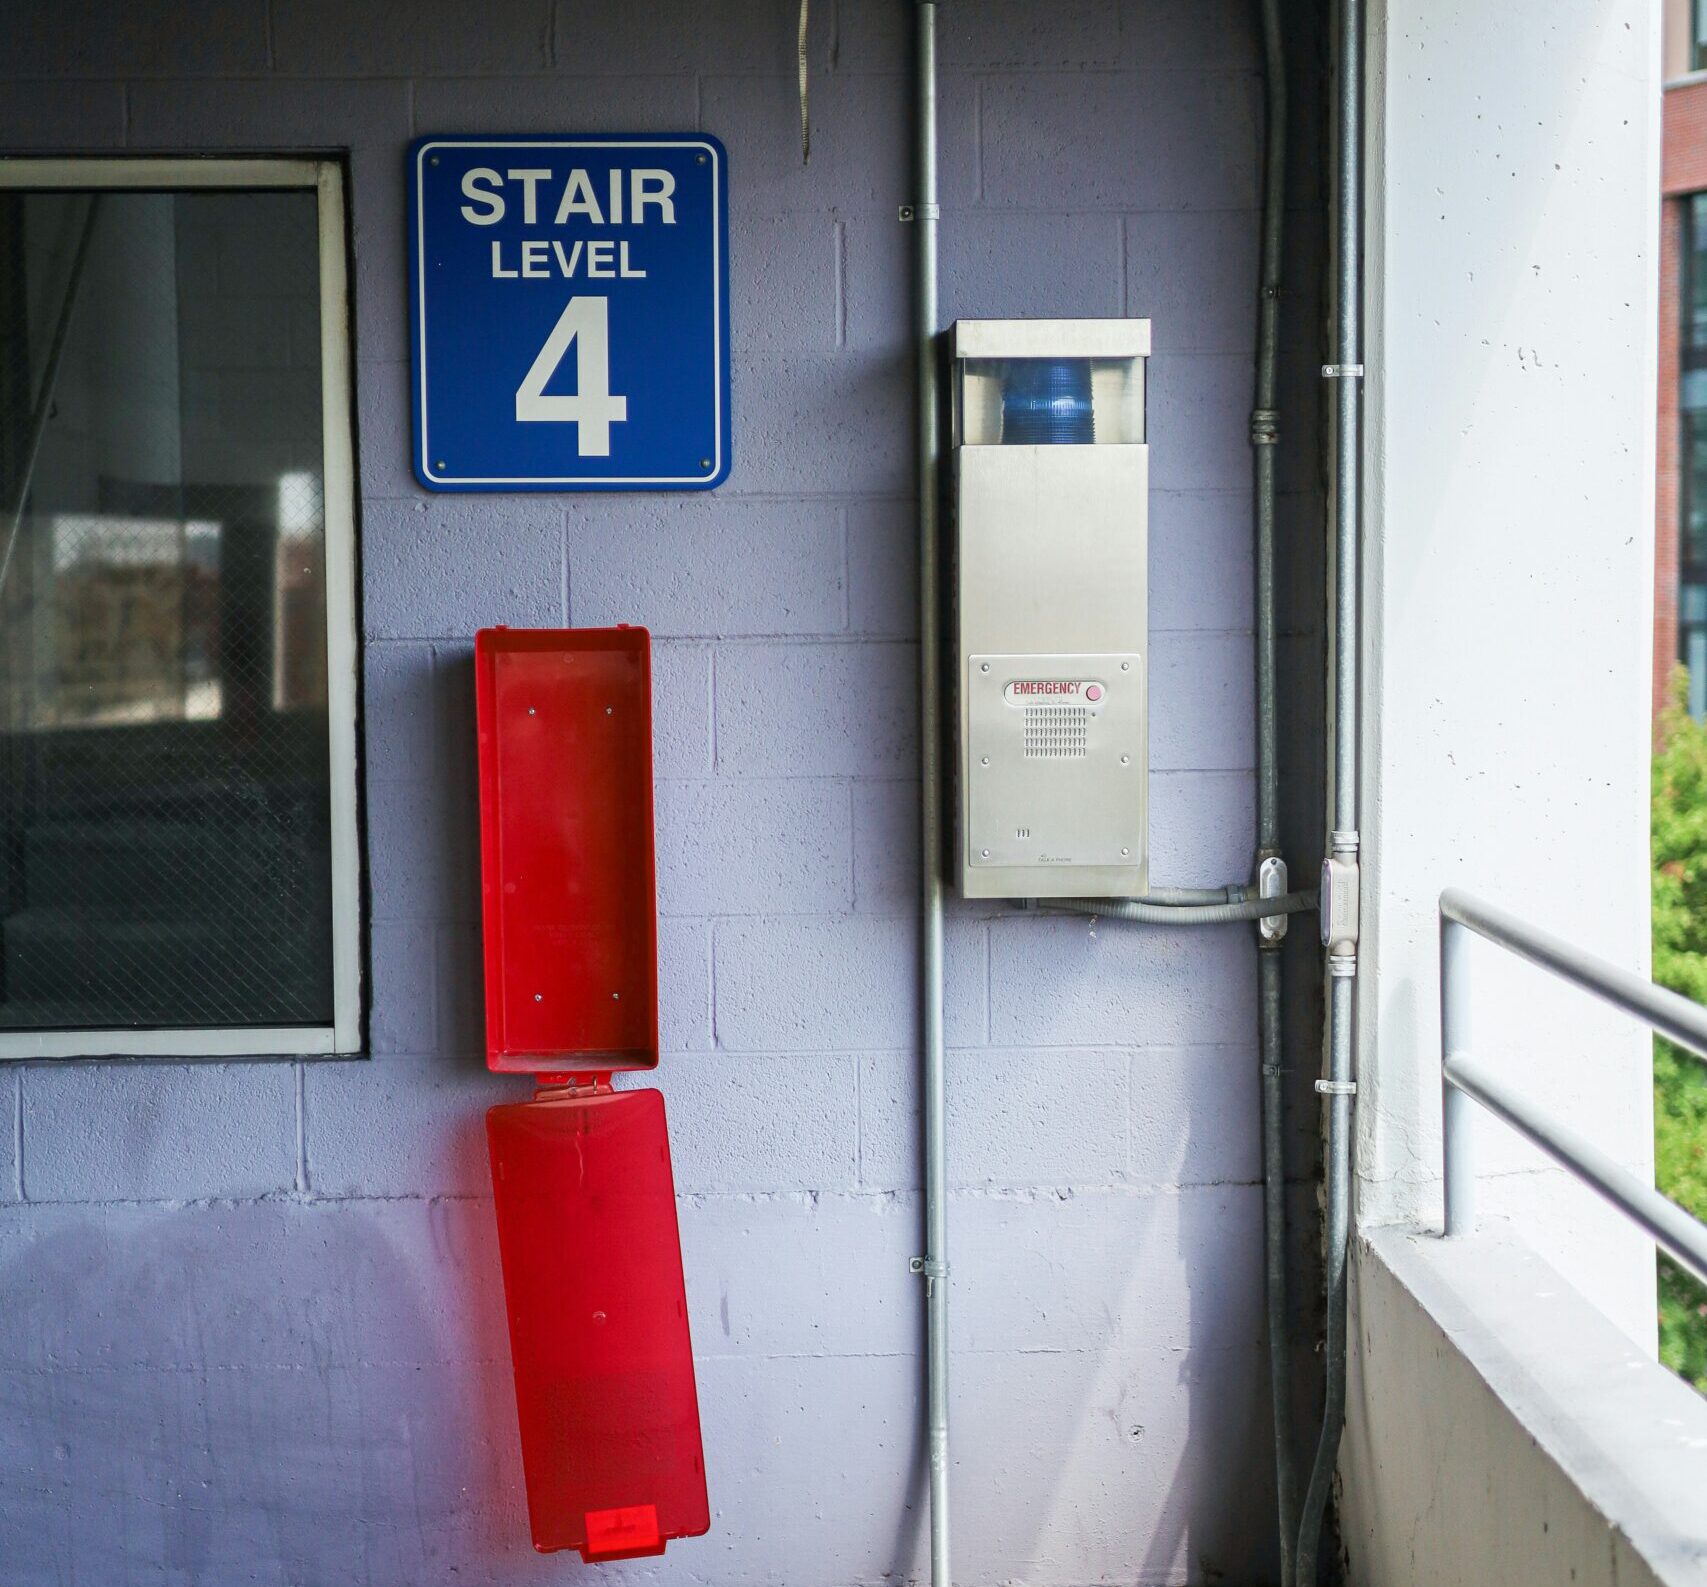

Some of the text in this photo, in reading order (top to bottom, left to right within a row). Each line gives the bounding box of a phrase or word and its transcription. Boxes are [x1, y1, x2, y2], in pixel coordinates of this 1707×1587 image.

[461, 167, 677, 226] STAIR
[492, 240, 647, 279] LEVEL
[515, 296, 627, 457] 4
[1013, 682, 1081, 695] EMERGENCY
